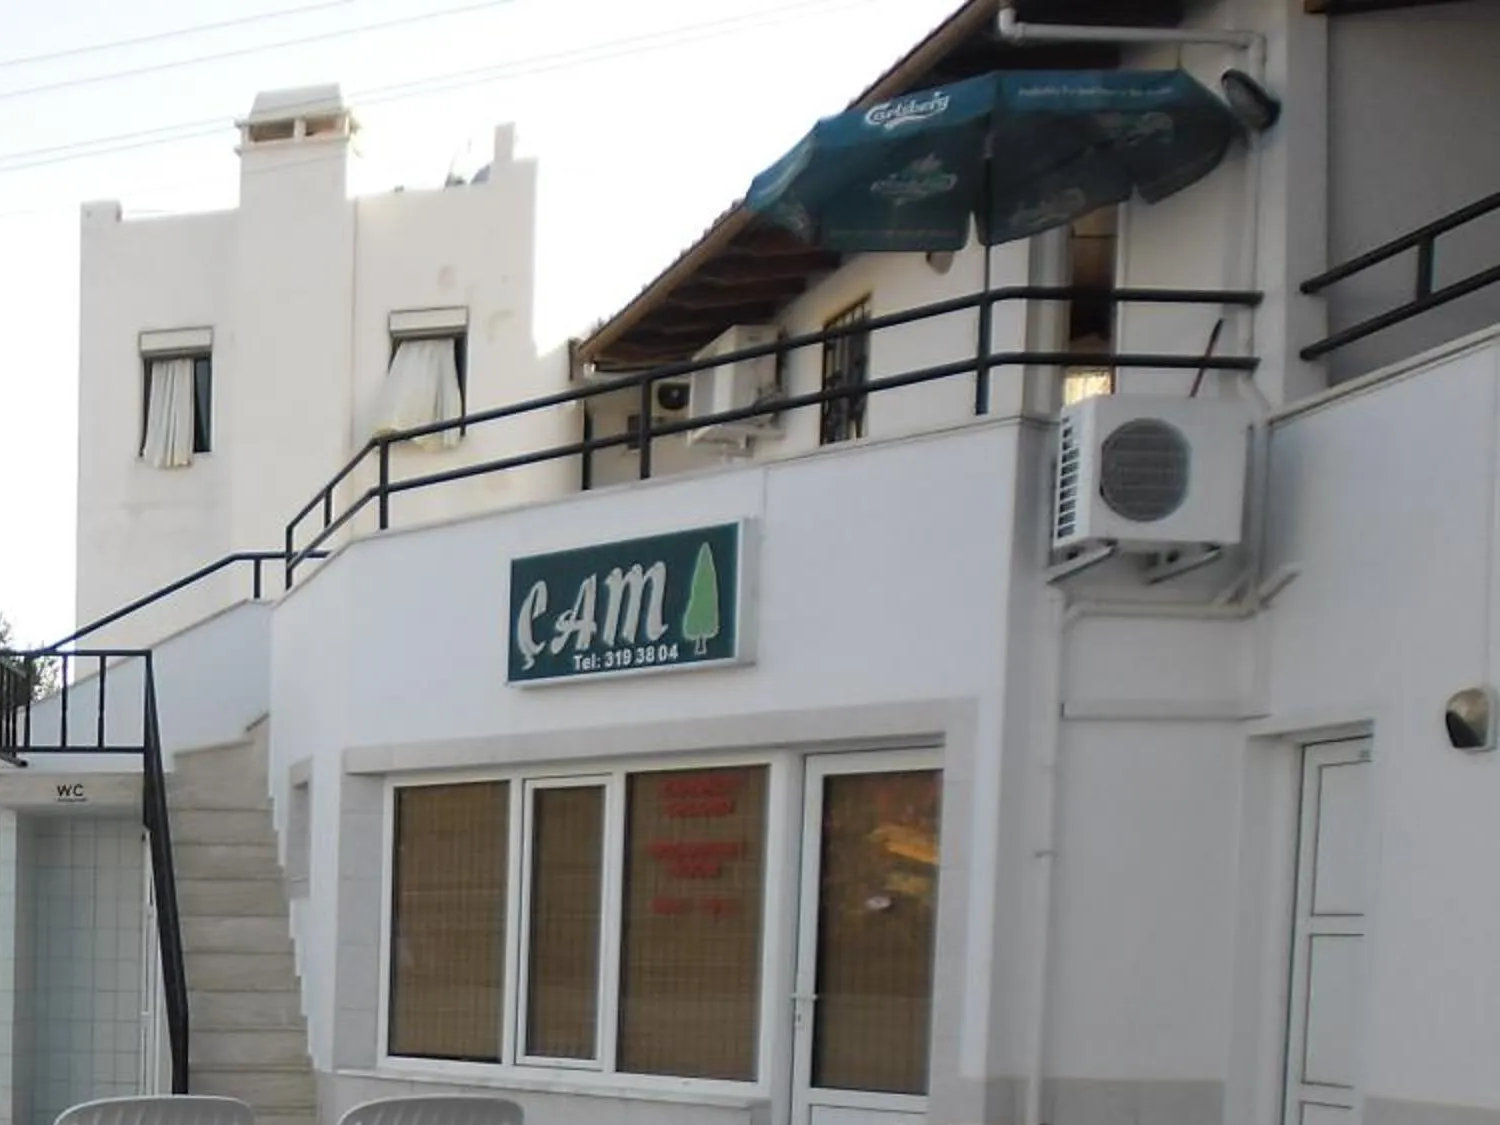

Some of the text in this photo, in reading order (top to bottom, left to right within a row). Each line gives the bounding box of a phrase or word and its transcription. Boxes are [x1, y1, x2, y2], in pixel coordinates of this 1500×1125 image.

[865, 91, 950, 130] Carlsberg
[573, 643, 679, 671] Tel: 319 38 04
[57, 783, 85, 797] WC
